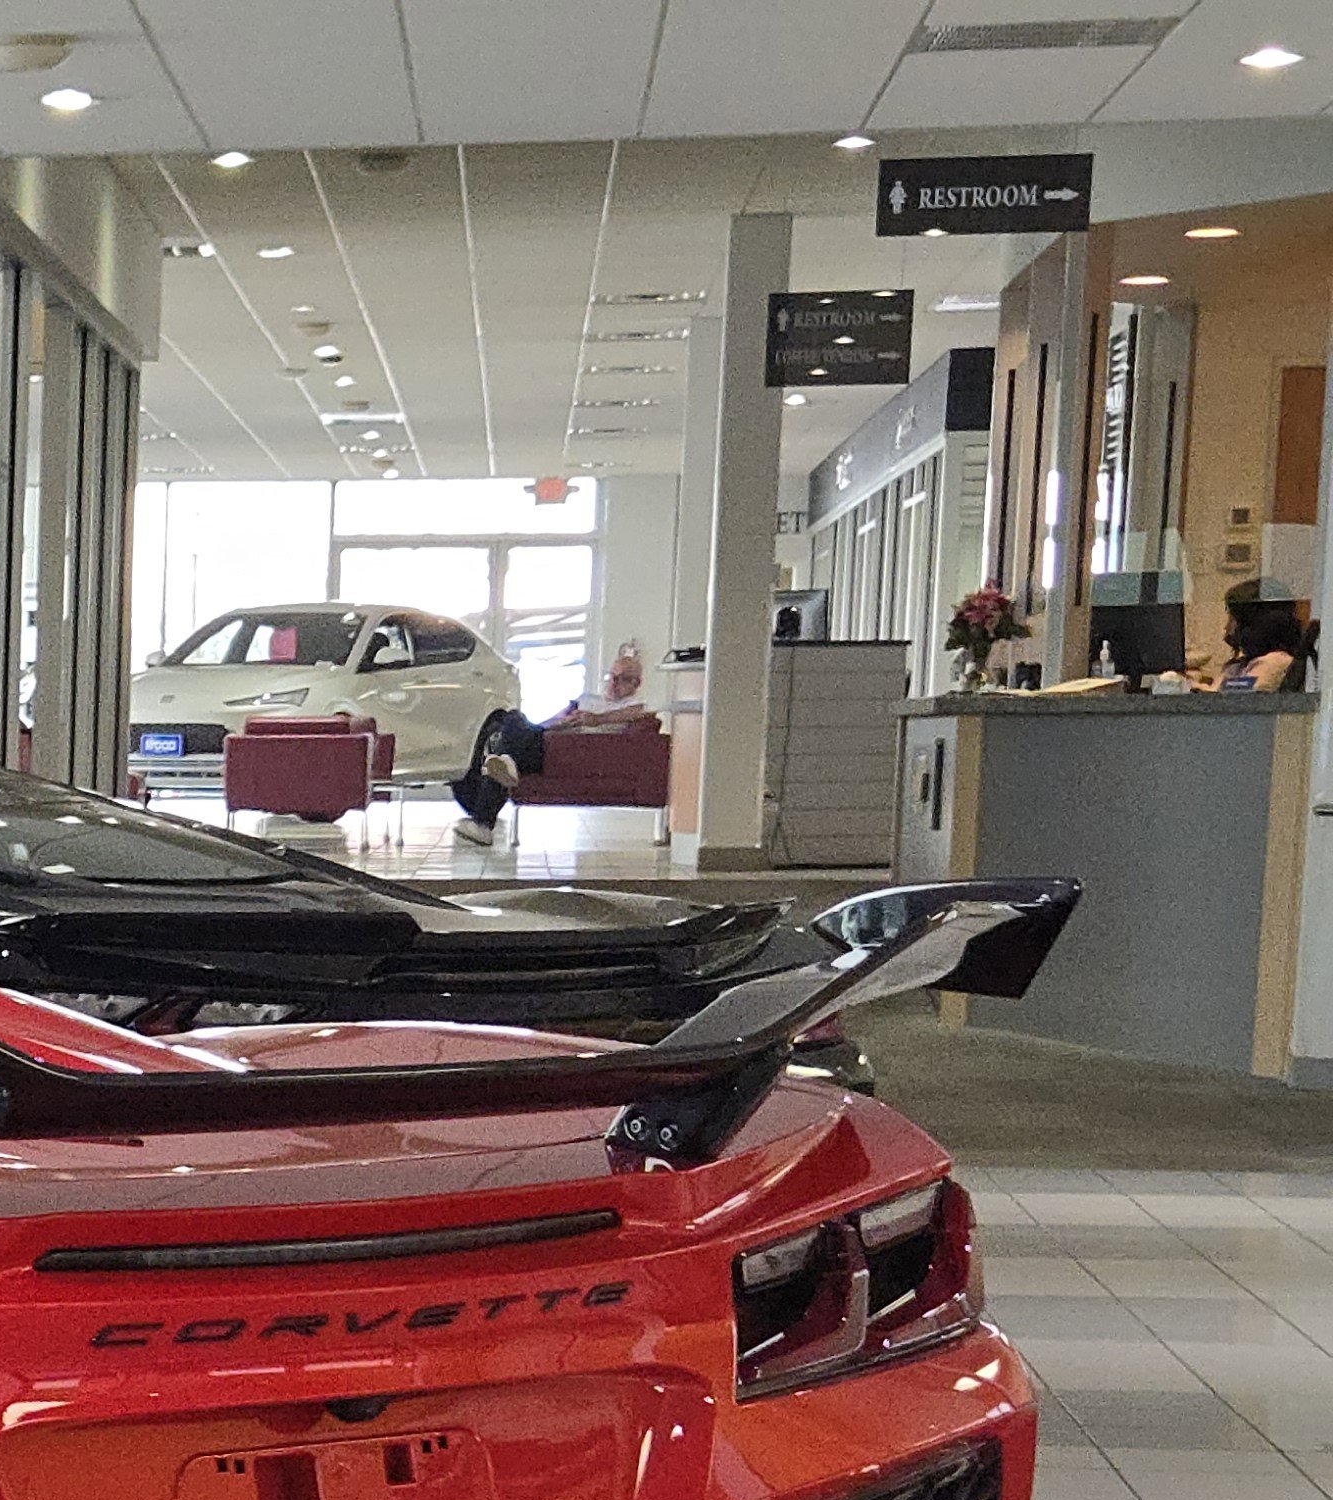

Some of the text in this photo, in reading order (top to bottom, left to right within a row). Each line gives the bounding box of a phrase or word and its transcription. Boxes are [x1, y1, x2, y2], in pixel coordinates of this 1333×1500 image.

[918, 184, 1042, 210] RESTROOM
[793, 310, 875, 328] RESTROOM
[91, 1280, 631, 1348] CORVETTE
